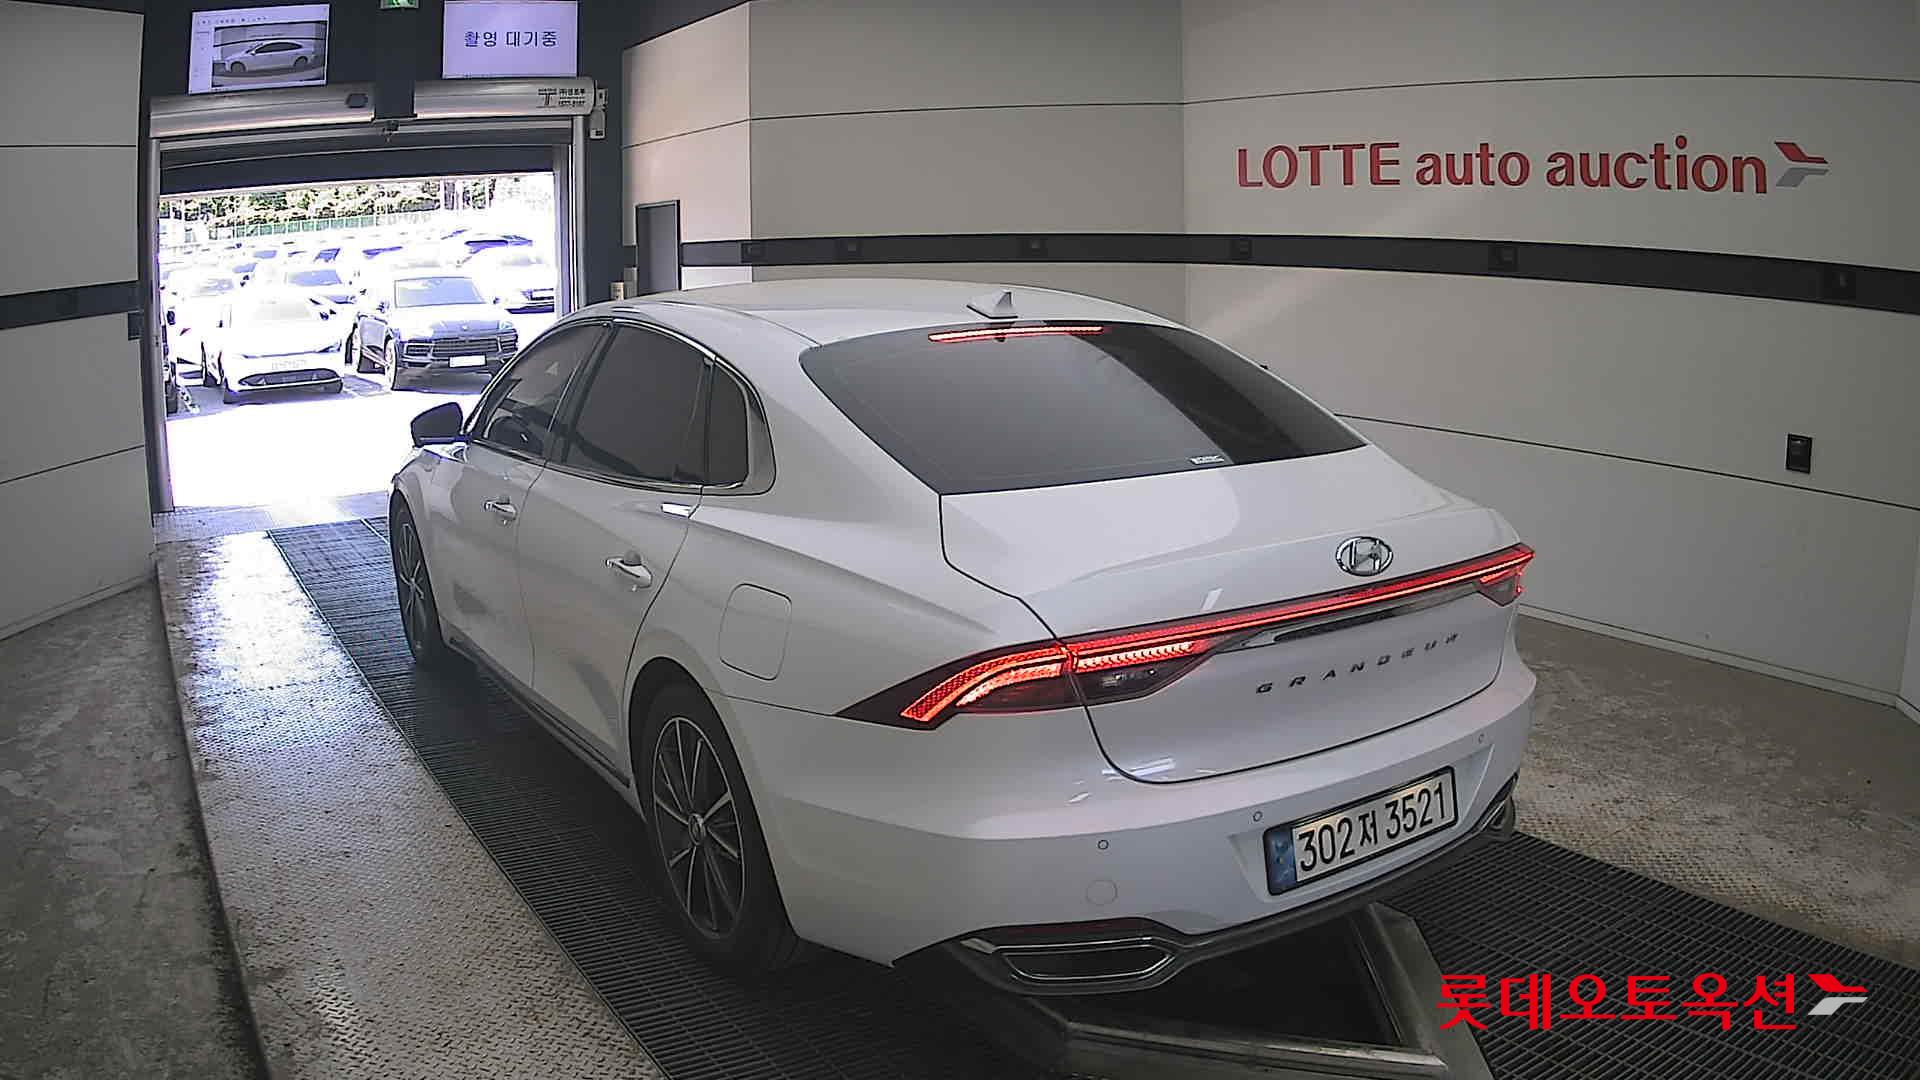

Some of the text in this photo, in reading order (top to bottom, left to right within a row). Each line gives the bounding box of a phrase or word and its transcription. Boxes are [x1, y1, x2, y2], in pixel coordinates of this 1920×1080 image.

[505, 31, 558, 48] 대기중
[1237, 135, 1768, 194] LOTTE auto auction
[1255, 632, 1459, 694] GRANDEUR
[1298, 781, 1446, 872] 302저 3521
